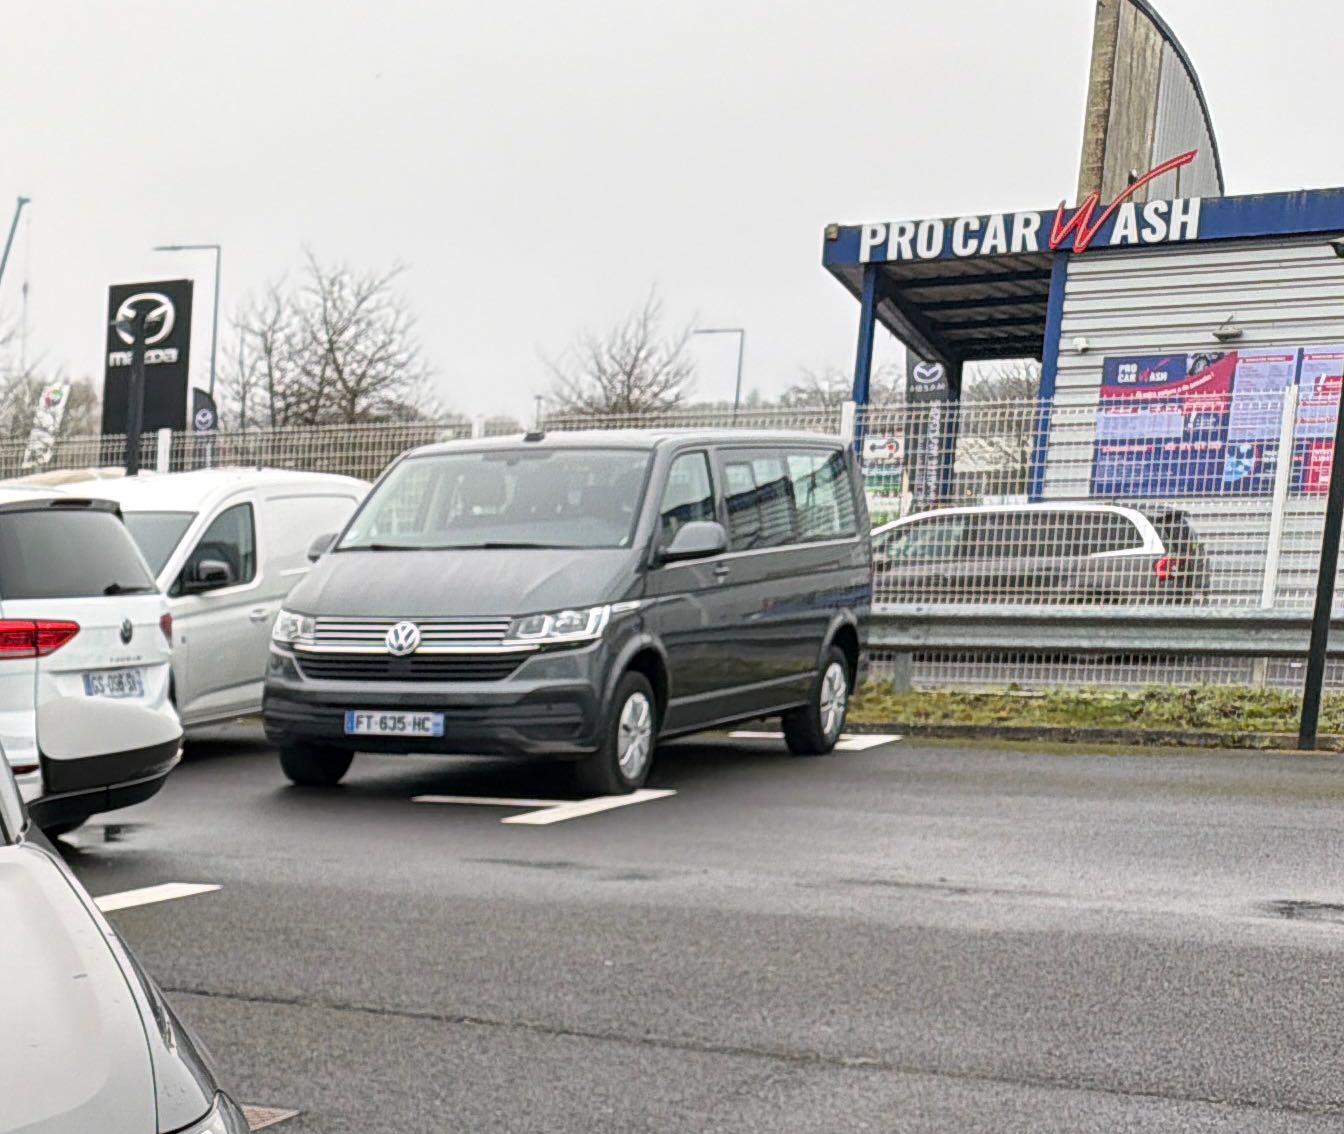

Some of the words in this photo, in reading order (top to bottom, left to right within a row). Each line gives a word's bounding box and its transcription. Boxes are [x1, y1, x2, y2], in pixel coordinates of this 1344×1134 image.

[859, 219, 944, 263] PRO
[952, 211, 1041, 257] CAR
[1049, 149, 1200, 253] WASH
